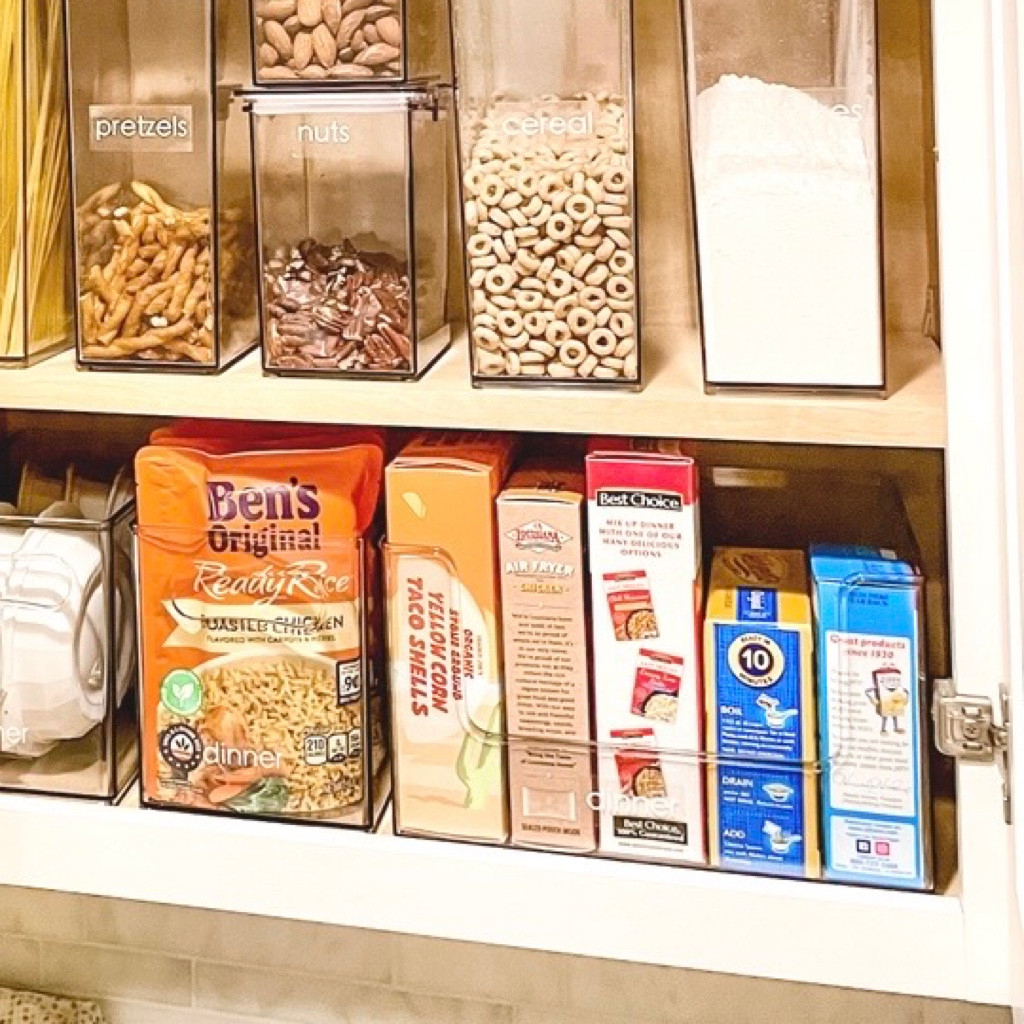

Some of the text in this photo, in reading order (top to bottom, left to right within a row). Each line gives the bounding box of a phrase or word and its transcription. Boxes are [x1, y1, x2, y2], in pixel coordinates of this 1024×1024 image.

[95, 114, 188, 141] pretzels
[297, 120, 350, 144] nuts
[501, 112, 594, 138] cereal
[207, 477, 321, 521] Ben's
[600, 492, 628, 506] Best
[207, 522, 321, 558] Original
[505, 561, 575, 577] AIR FRYER
[193, 560, 350, 605] Ready Rice
[407, 577, 429, 717] TACO SHELLS
[428, 591, 448, 714] YELLOW CORN
[463, 629, 474, 679] ORGANIC
[861, 638, 905, 650] products
[742, 648, 771, 670] 10
[739, 673, 773, 685] MINUTES
[203, 742, 283, 769] dinner
[722, 776, 754, 788] DRAIN
[723, 829, 746, 839] ADD
